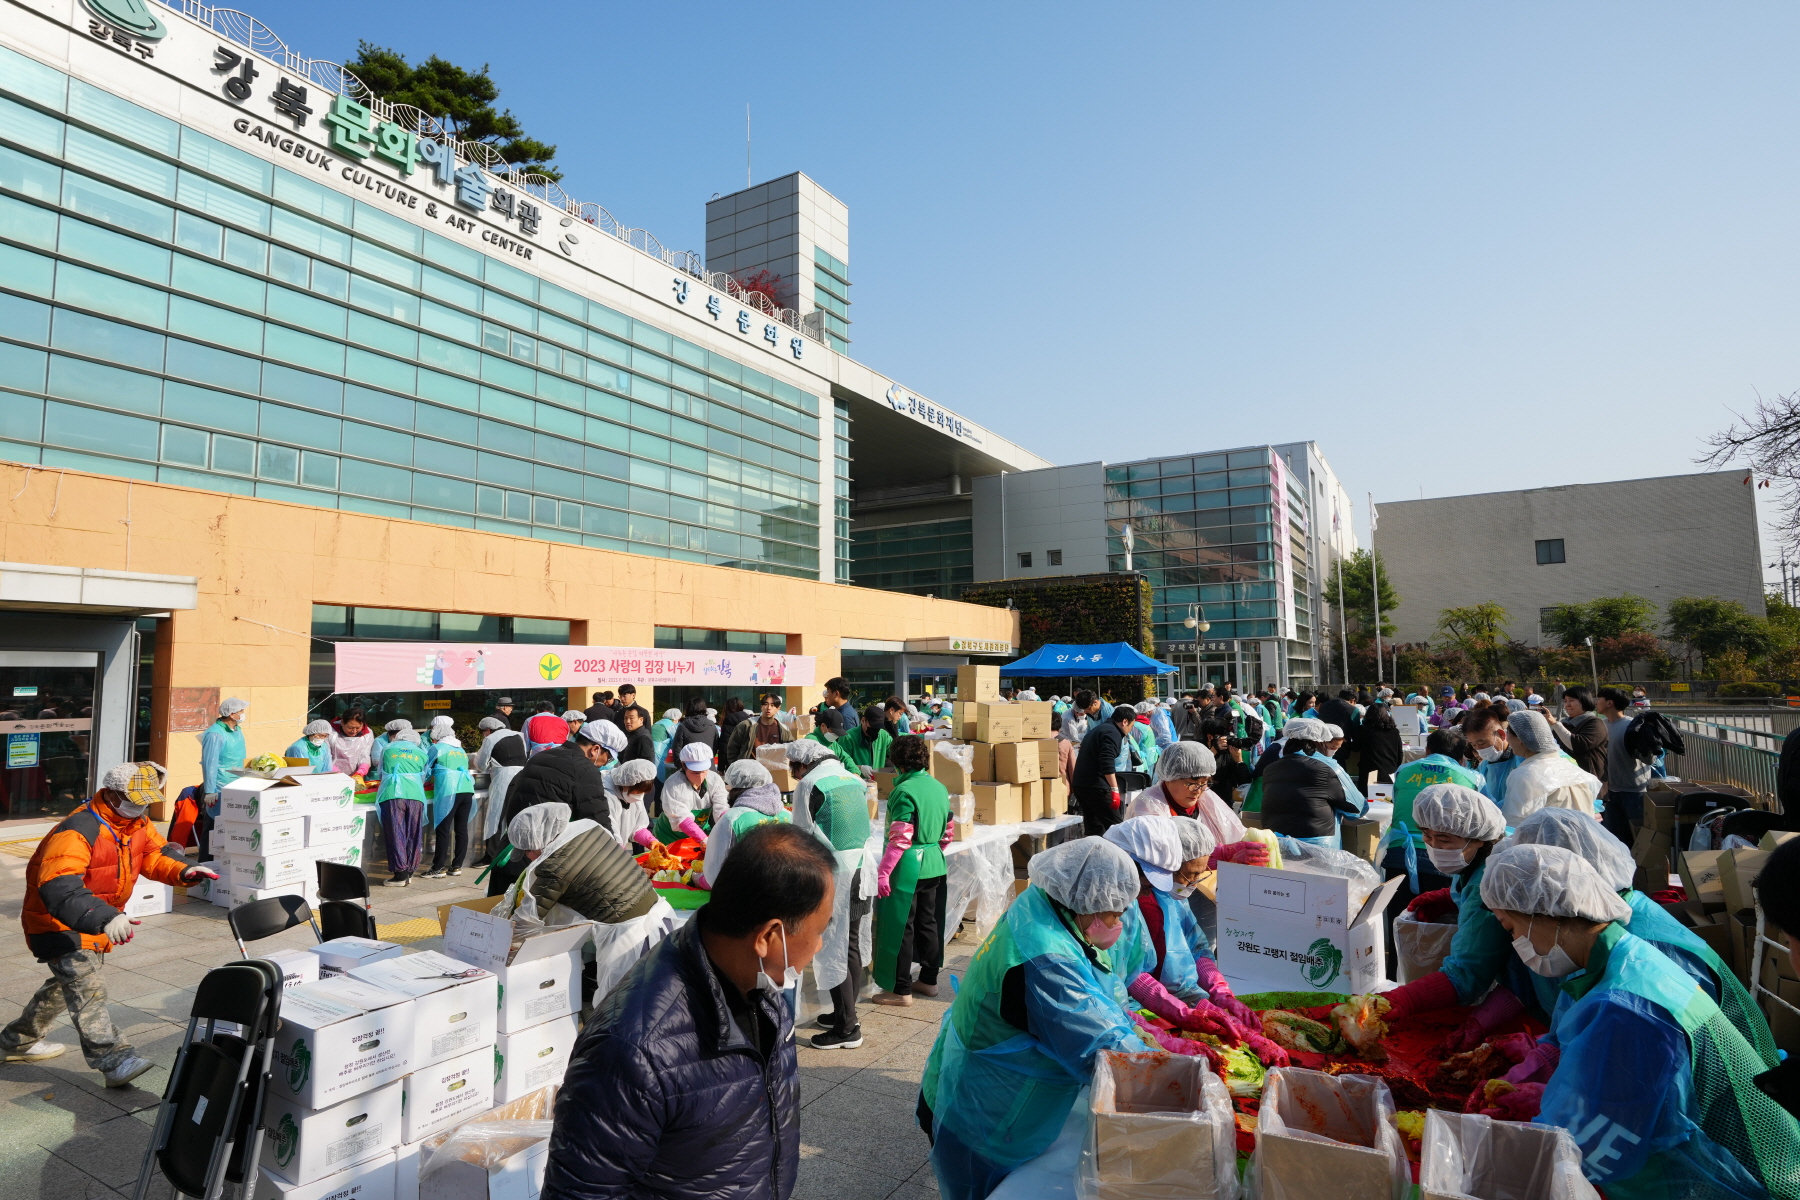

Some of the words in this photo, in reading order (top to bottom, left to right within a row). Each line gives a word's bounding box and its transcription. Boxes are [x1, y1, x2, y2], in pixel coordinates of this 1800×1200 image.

[88, 18, 155, 60] 강북구
[233, 118, 334, 172] GANGBUK
[341, 166, 419, 210] CULTURE
[425, 202, 438, 219] &
[445, 213, 477, 235] ART
[481, 229, 534, 261] CENTER
[908, 396, 963, 437] 강북문화재단
[1056, 654, 1104, 663] 인수동
[573, 659, 606, 673] 2023
[609, 659, 641, 674] 사랑의
[644, 660, 665, 674] 김장
[667, 661, 696, 675] 나누기
[1420, 763, 1446, 774] SMU
[1225, 927, 1255, 940] 청정지역
[1237, 940, 1261, 954] 강원도
[1263, 946, 1288, 960] 고랭지
[1289, 951, 1324, 967] 절임배추
[351, 1031, 374, 1044] 김장걱정
